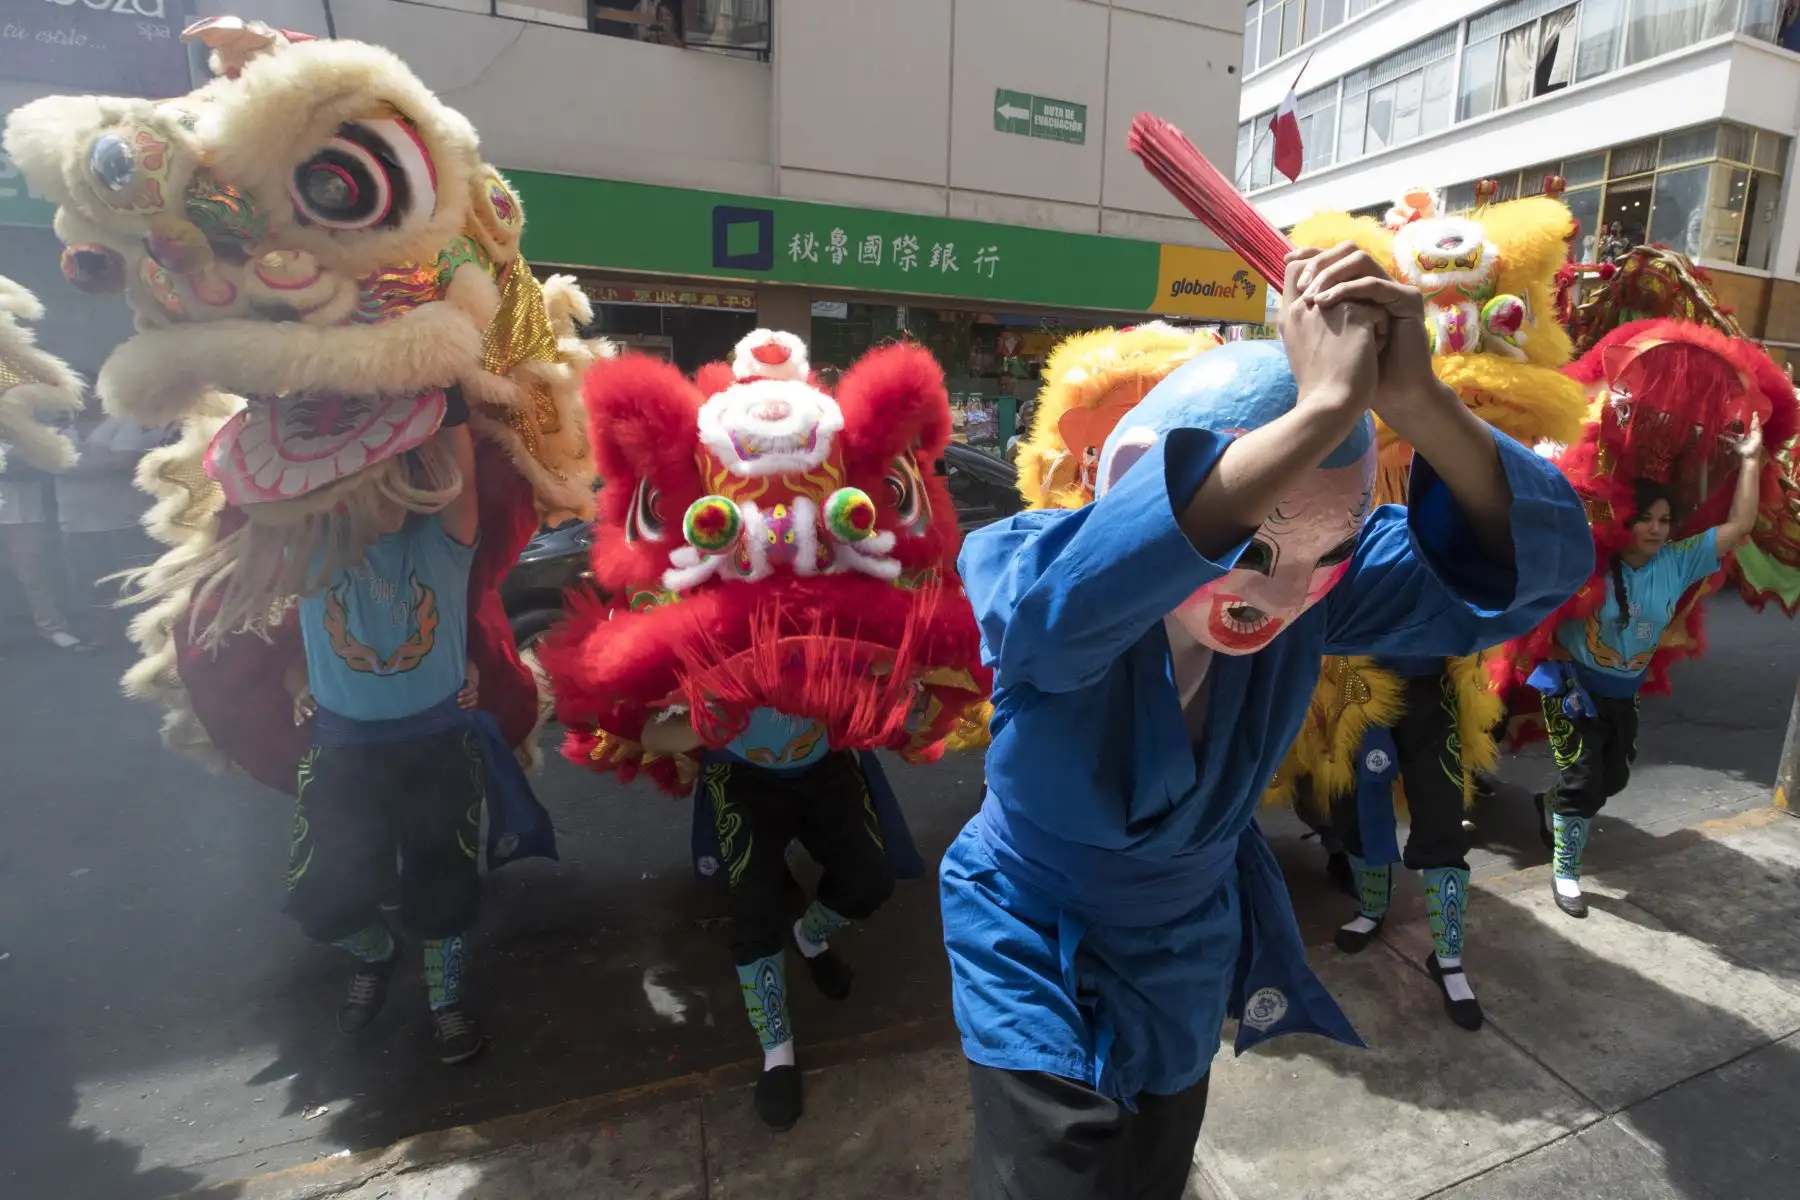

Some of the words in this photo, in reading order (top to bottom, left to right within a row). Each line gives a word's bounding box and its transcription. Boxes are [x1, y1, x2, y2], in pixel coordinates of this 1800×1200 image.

[136, 22, 171, 41] spa
[1065, 108, 1075, 120] DE
[787, 226, 1000, 279] 秘魯國際銀行
[1170, 277, 1240, 299] globalnet
